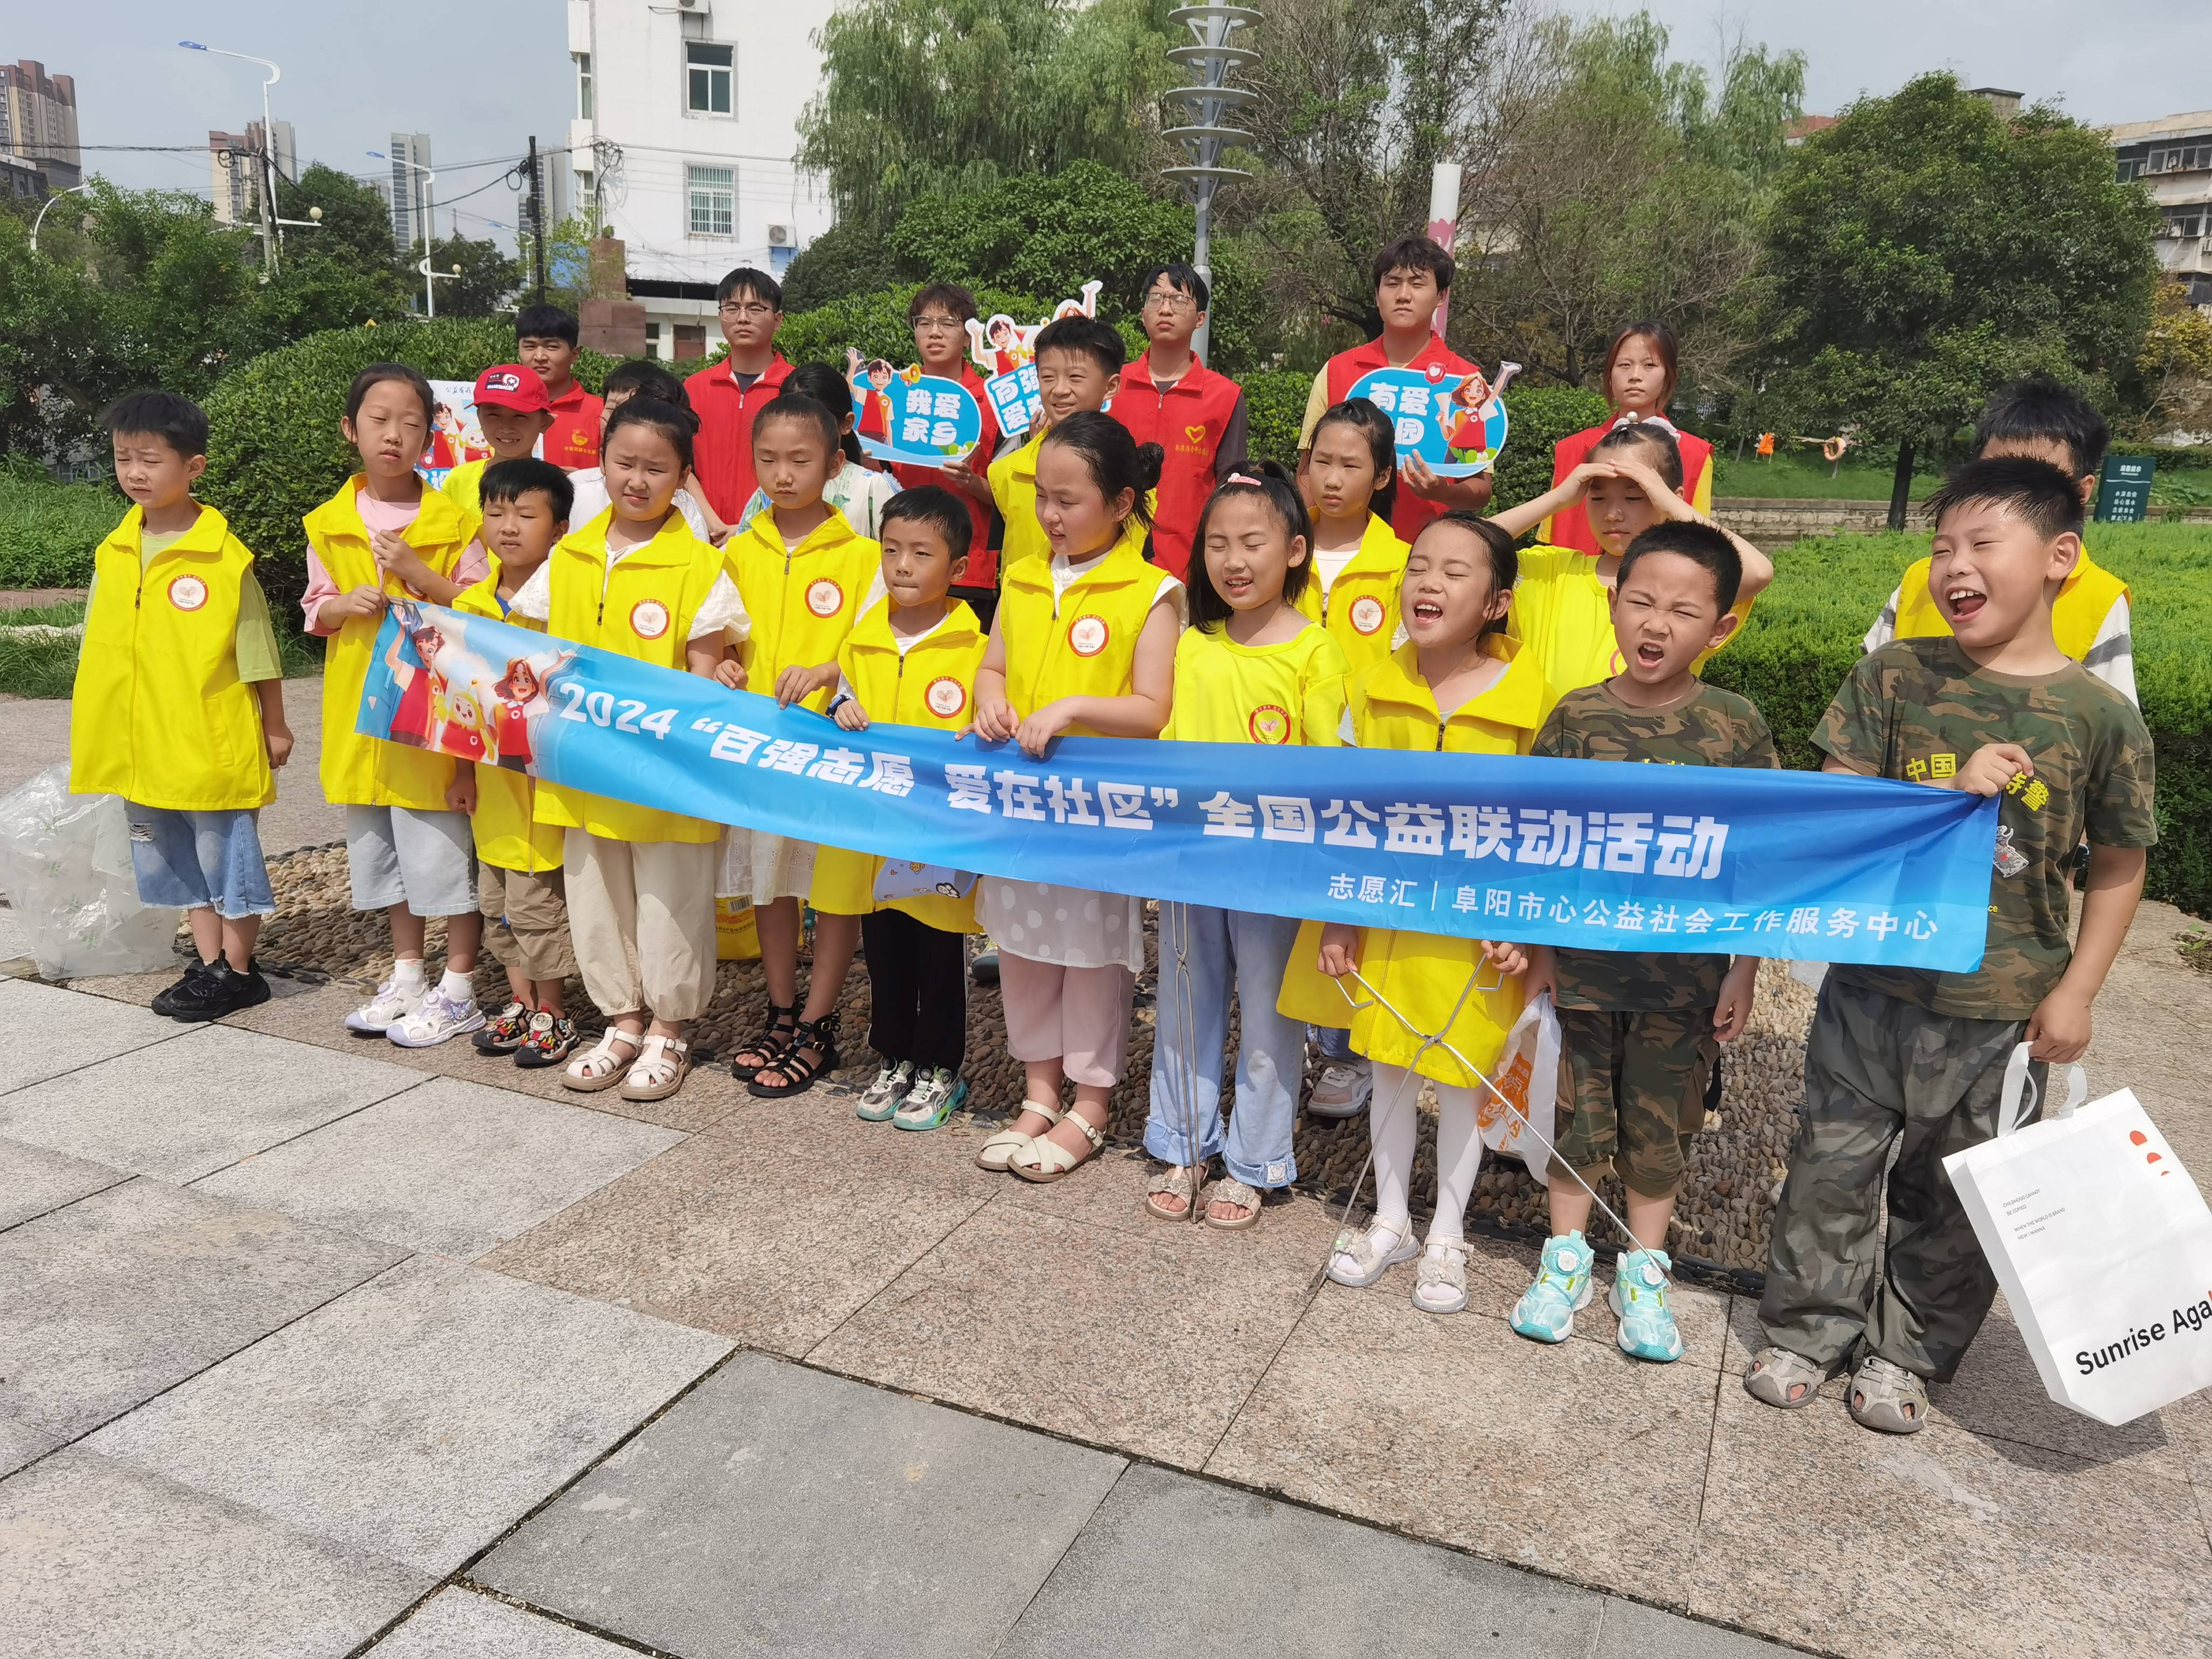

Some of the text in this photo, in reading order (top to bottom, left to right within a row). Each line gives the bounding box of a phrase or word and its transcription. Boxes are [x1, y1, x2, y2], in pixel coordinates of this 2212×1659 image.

[906, 389, 961, 420] 我爱
[1369, 382, 1429, 416] 有爱
[902, 417, 957, 446] 家乡
[1393, 417, 1425, 446] 园
[558, 682, 680, 740] 2024
[1198, 791, 1730, 880] 全国公益联动活动
[2014, 1223, 2027, 1232] WHEN
[2035, 1215, 2048, 1224] WORLD
[2052, 1207, 2066, 1216] BRAND
[2076, 1290, 2212, 1375] Sunrise Aga
